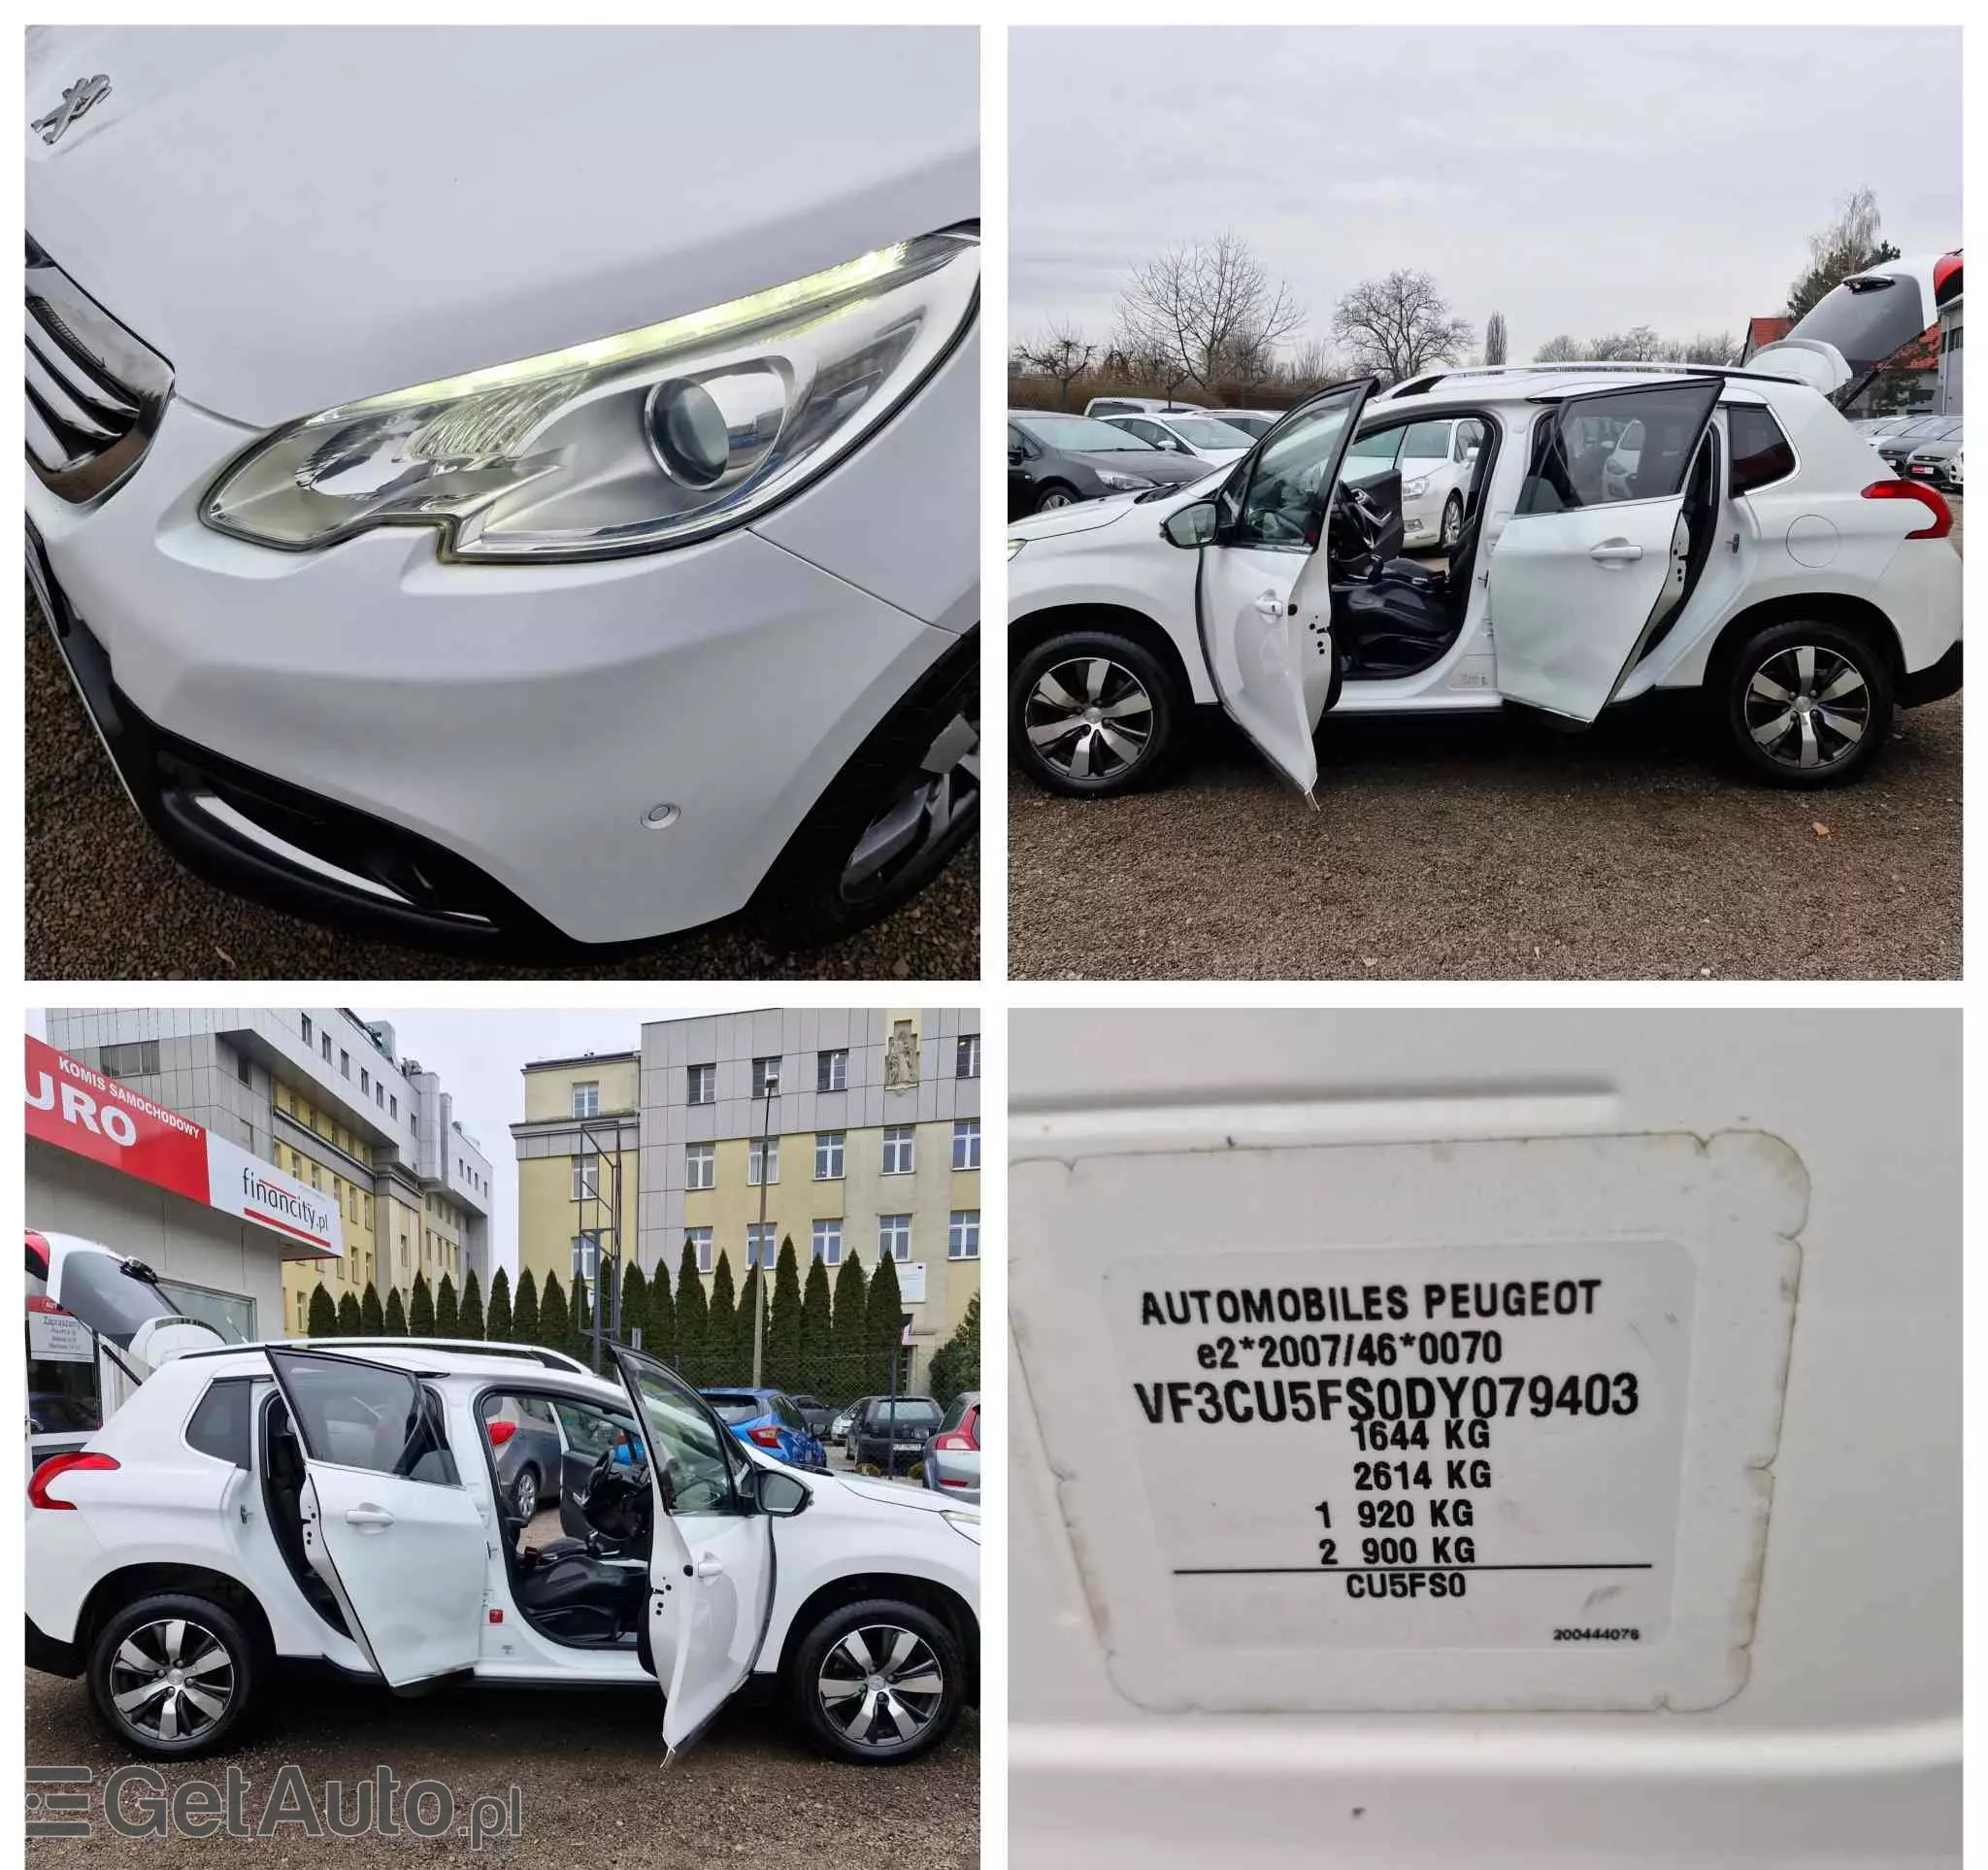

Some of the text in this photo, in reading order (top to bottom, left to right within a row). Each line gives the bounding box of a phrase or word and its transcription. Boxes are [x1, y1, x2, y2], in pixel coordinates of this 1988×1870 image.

[58, 1055, 200, 1139] KOMIS SAMOCHODOWY
[242, 1167, 328, 1234] financity.pl
[1142, 1279, 1602, 1325] AUTOMOBILES PEUGEOT
[1133, 1372, 1640, 1424] VF3CU5FS0DY079403
[1350, 1418, 1491, 1452] 1644 KG
[1353, 1459, 1492, 1491] 2614 KG
[1314, 1498, 1474, 1529] 1 920 KG
[1318, 1536, 1475, 1566] 2 900 KG
[1345, 1572, 1467, 1599] CU5FS0
